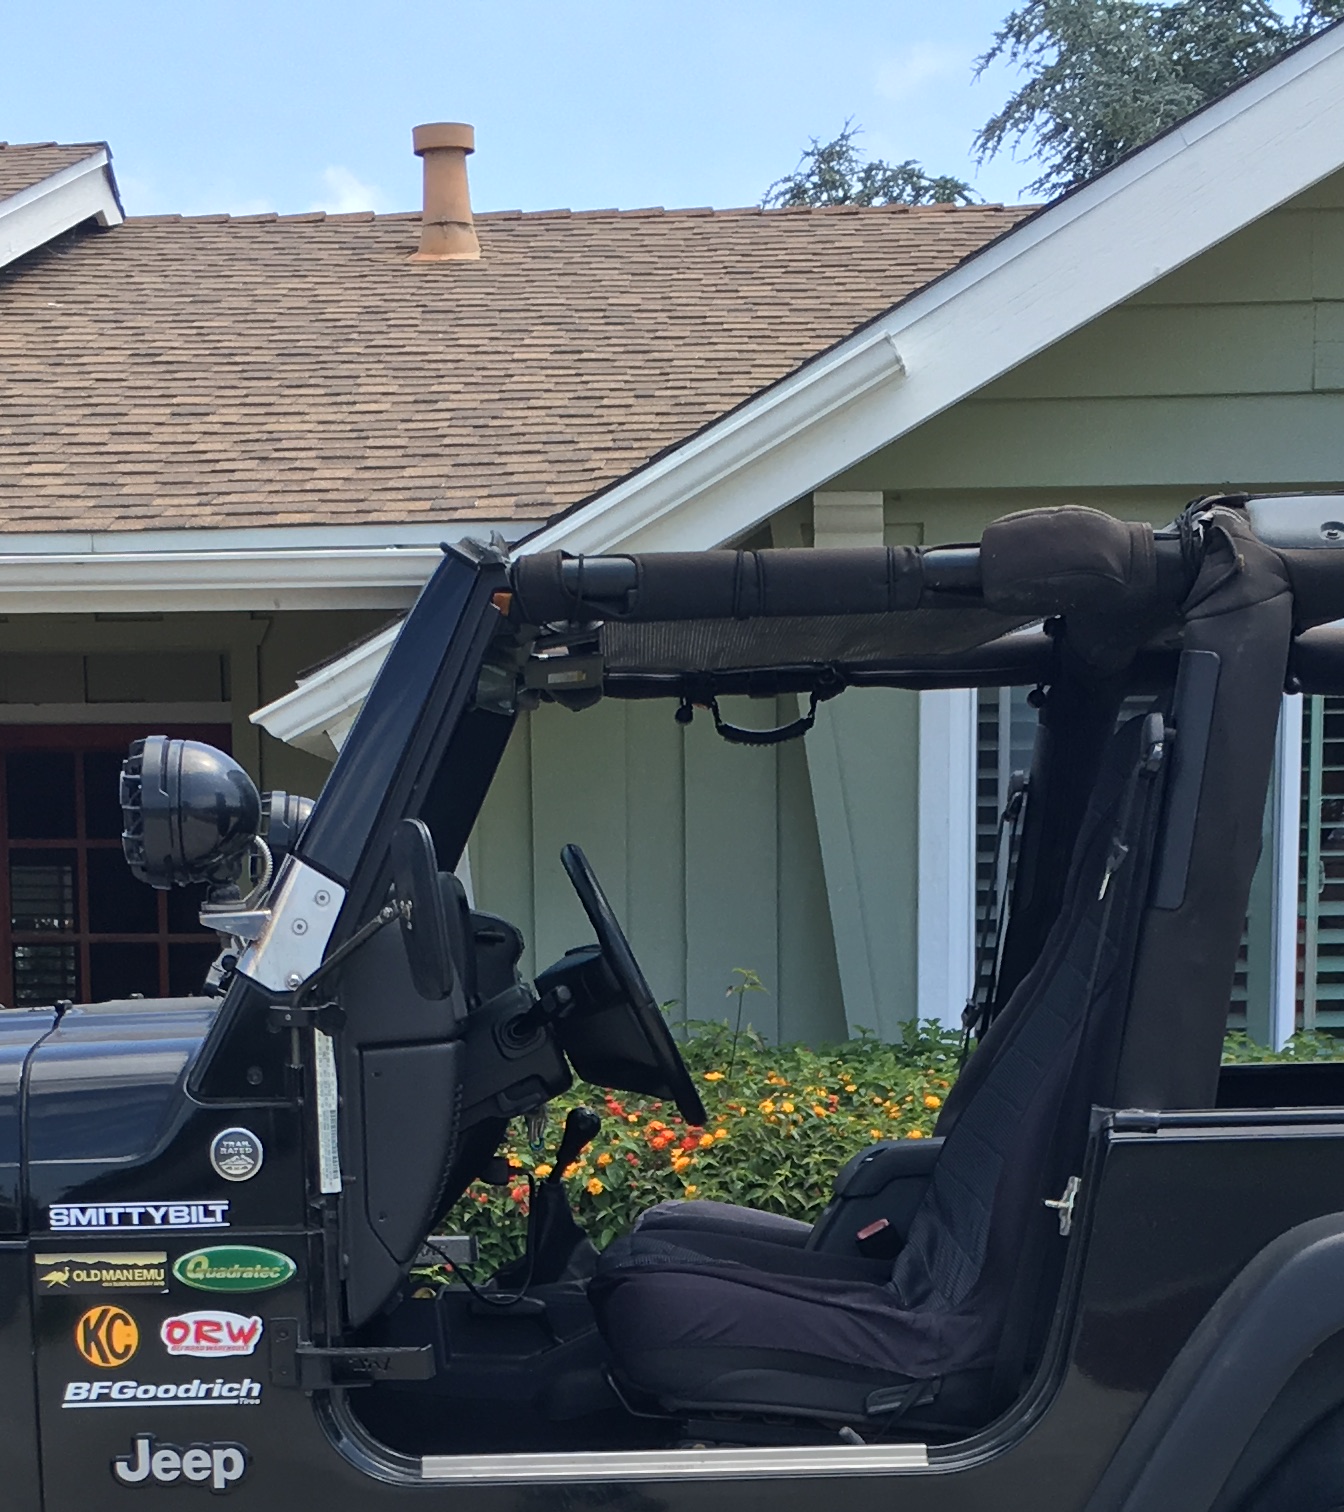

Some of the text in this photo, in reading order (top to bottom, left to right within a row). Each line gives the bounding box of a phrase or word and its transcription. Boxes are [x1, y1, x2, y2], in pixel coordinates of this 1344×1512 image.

[49, 1204, 229, 1227] SMITTYBILT
[72, 1268, 165, 1281] OLD MAN EMU
[186, 1256, 281, 1280] Quadratec
[83, 1308, 132, 1364] KC
[166, 1318, 259, 1345] ORW
[64, 1378, 261, 1400] BFGoodrich
[115, 1438, 245, 1489] Jeep
